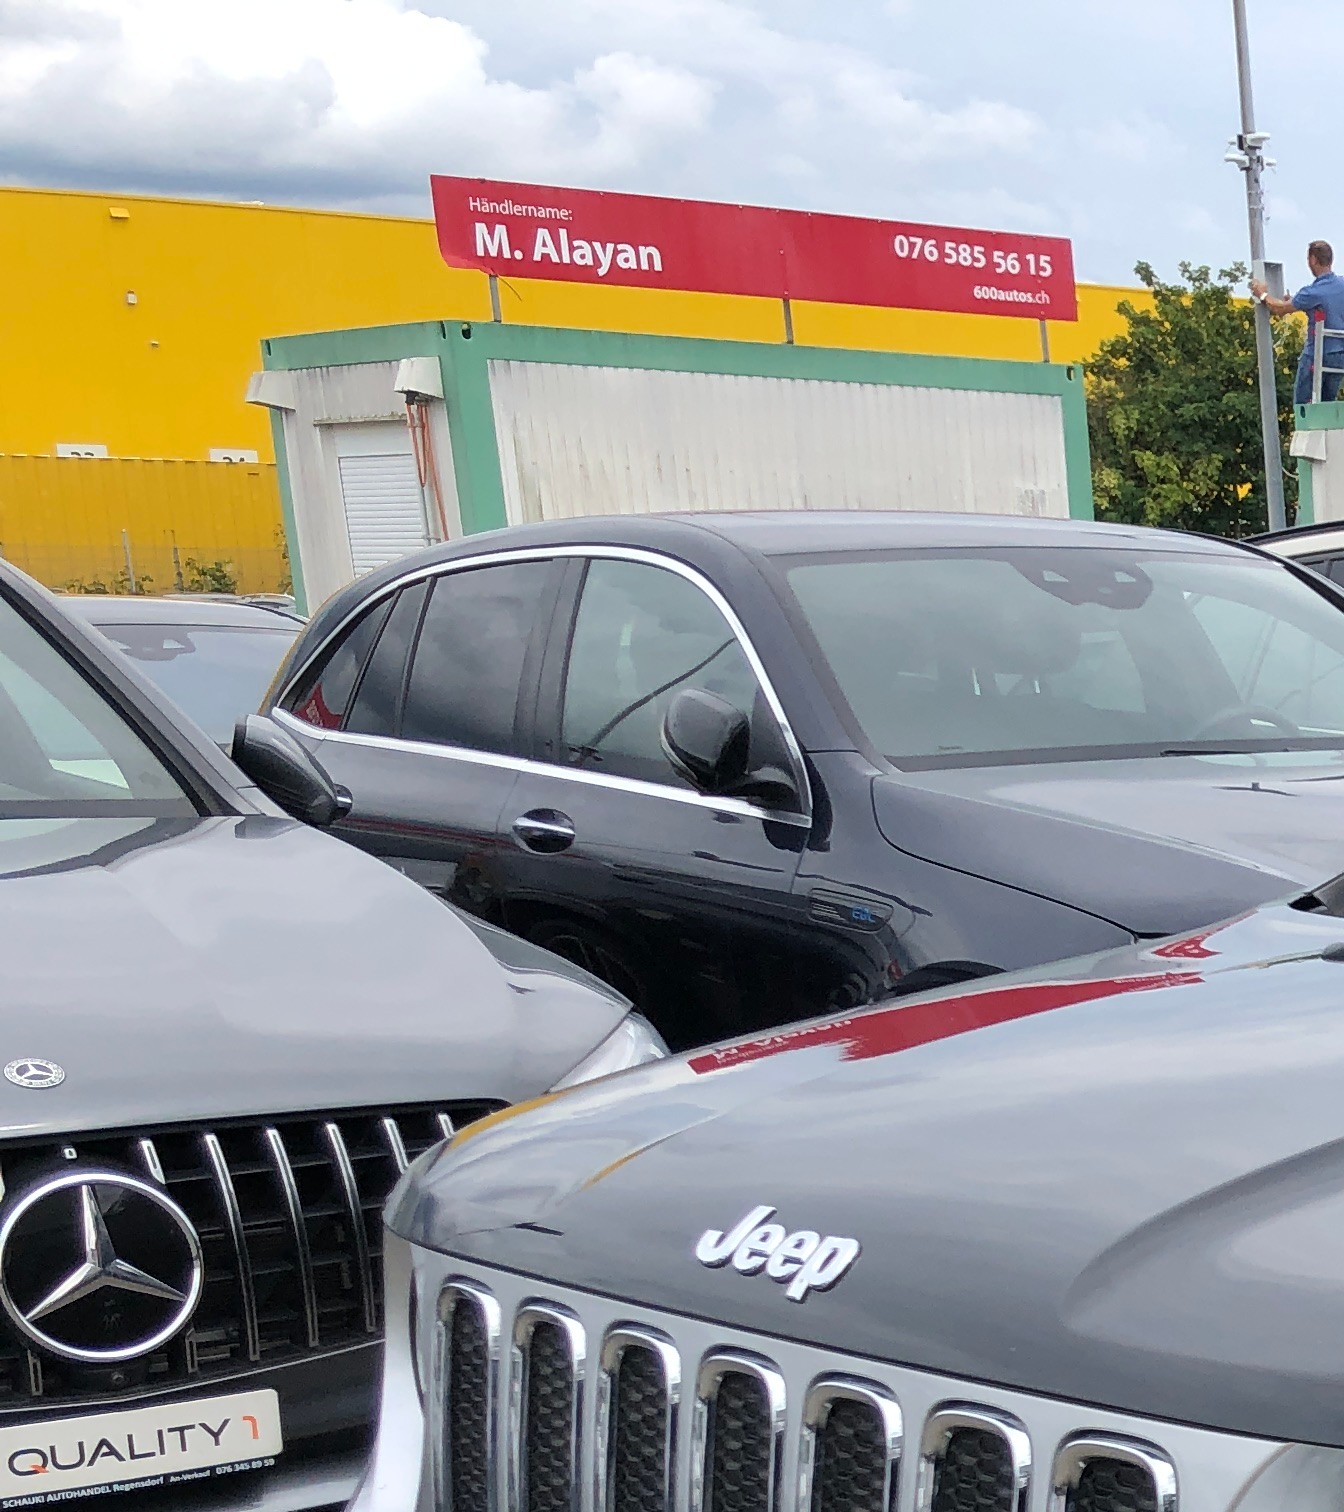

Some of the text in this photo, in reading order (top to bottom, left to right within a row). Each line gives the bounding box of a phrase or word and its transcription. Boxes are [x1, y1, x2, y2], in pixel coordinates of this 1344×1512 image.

[468, 196, 573, 221] Händlername:
[474, 222, 663, 277] M. Alayan
[893, 234, 1053, 278] 076 585 56 15
[973, 285, 1050, 304] 600autos.ch
[695, 1205, 862, 1304] Jeep
[8, 1415, 259, 1477] QUALITY 1
[2, 1495, 45, 1509] SCHAUKI
[47, 1486, 111, 1502] AUTOHANDEL
[113, 1476, 164, 1493] Regensdorf
